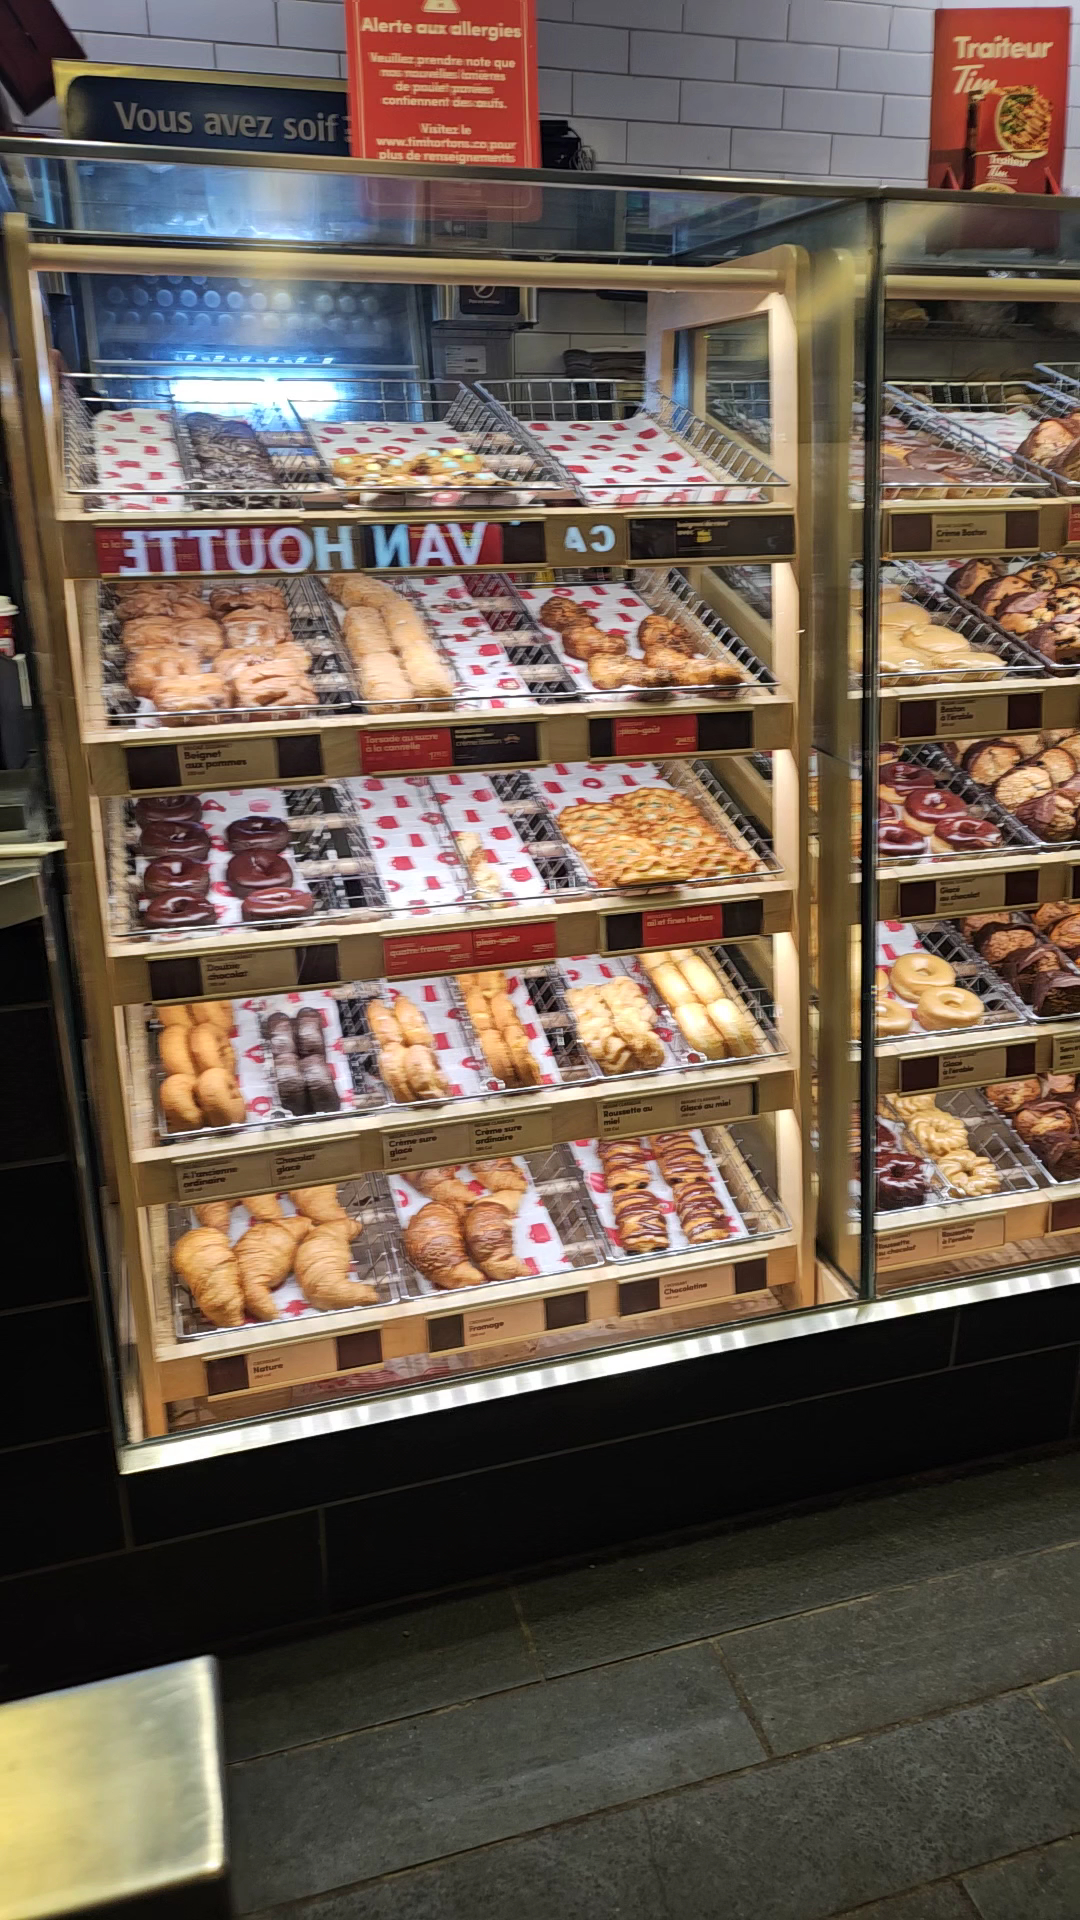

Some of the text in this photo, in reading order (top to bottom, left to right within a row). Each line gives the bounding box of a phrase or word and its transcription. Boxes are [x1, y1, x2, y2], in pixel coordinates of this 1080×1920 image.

[360, 17, 522, 41] Alerte aux allergies
[952, 35, 1054, 59] Traiteur
[416, 54, 463, 67] prendre
[466, 56, 491, 67] note
[494, 58, 516, 70] que
[382, 96, 449, 107] contiennent
[114, 101, 193, 135] Vous
[204, 113, 273, 140] avez
[284, 112, 339, 142] soif
[420, 123, 472, 135] Visitez le
[378, 149, 403, 161] plus
[406, 150, 421, 161] de
[184, 750, 221, 761] Beignet
[206, 758, 247, 770] pommes
[715, 1099, 731, 1108] miel
[603, 1105, 653, 1118] Roussette au
[603, 1118, 620, 1126] miel
[475, 1124, 522, 1136] Crème sure
[389, 1135, 437, 1148] Crème sure
[475, 1134, 513, 1145] ordinaire
[664, 1282, 708, 1295] Chocolatine
[469, 1321, 504, 1332] Fromage
[253, 1362, 284, 1374] Nature
